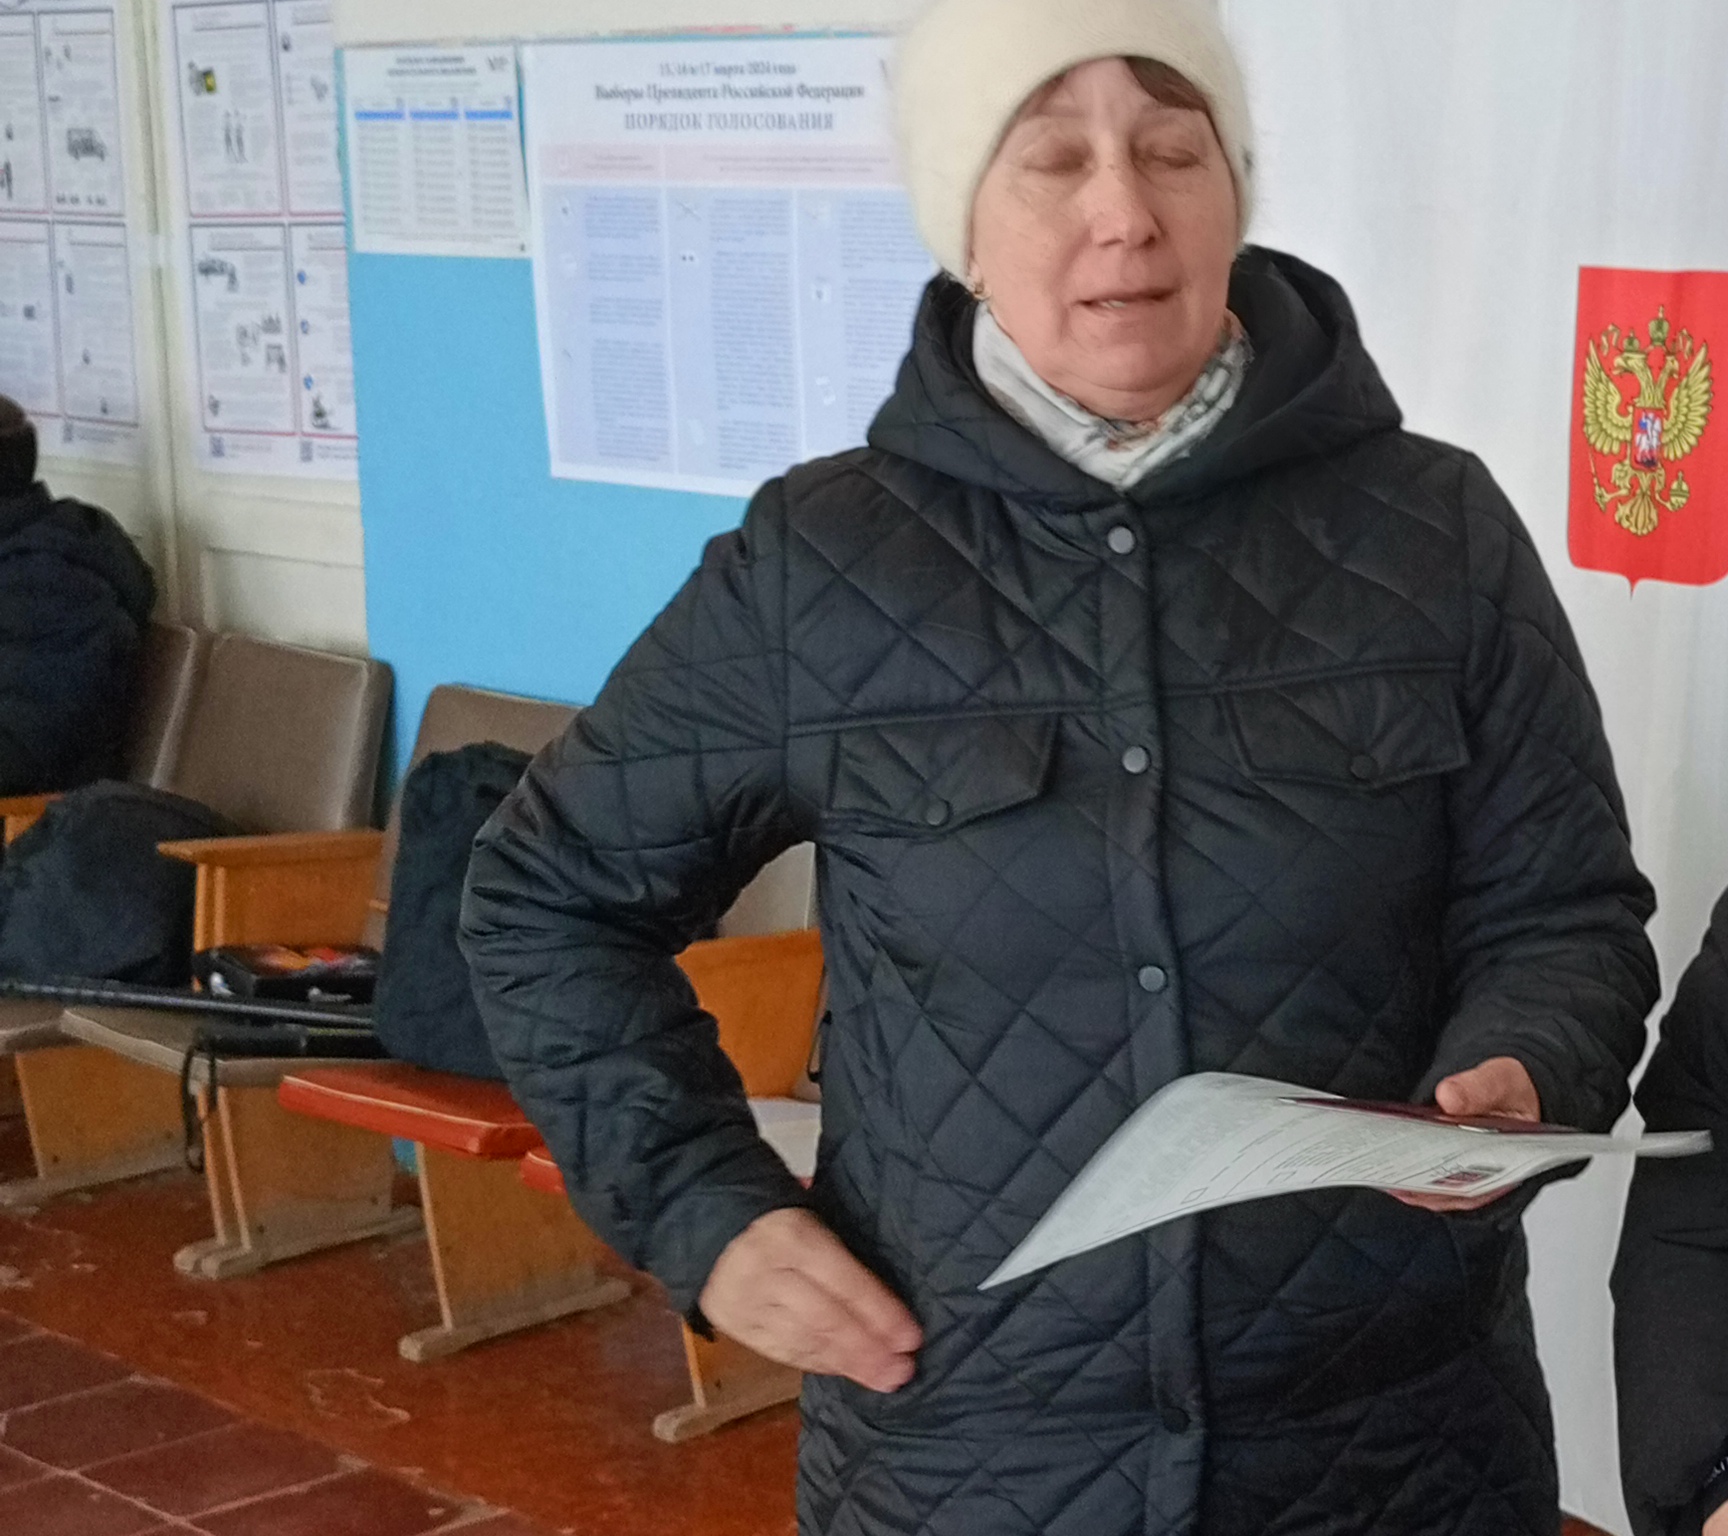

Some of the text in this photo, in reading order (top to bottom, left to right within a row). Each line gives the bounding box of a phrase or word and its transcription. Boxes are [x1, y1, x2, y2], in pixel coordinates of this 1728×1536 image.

[595, 83, 865, 104] Выборы Президента Российской Федерации
[624, 113, 833, 131] ПОРЯДОК ГОЛОСОВАНИЯ
